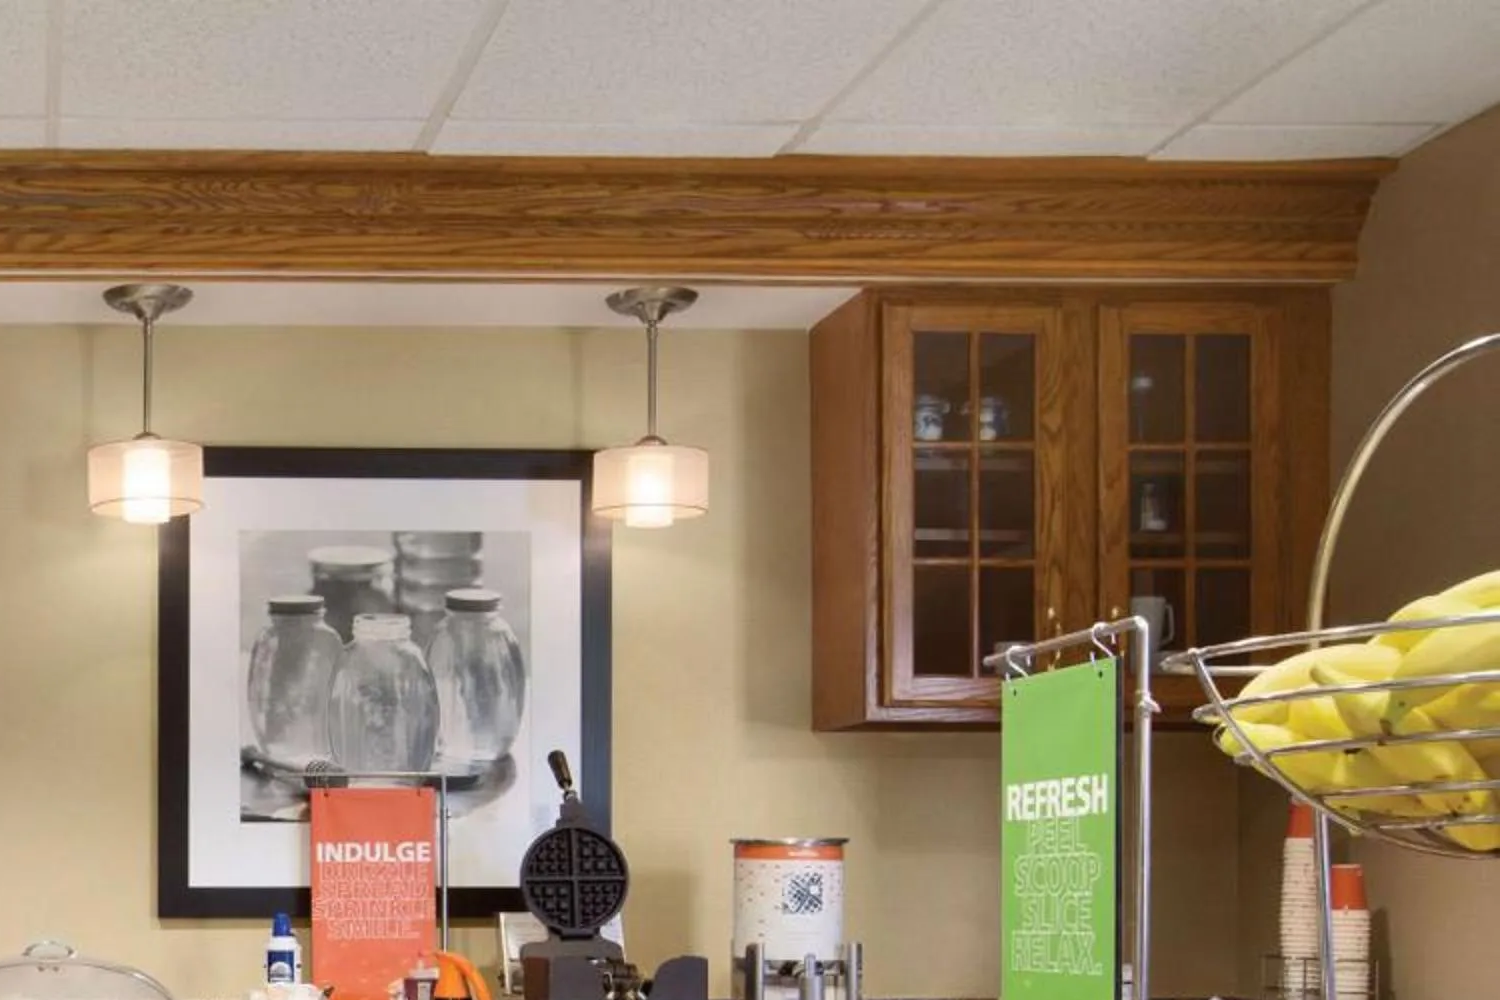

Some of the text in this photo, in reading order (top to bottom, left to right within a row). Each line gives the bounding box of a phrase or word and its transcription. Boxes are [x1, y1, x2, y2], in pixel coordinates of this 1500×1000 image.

[1007, 774, 1108, 820] REFRESH
[316, 841, 432, 863] INDULGE
[1014, 852, 1101, 896] SCOOP
[1021, 892, 1093, 932] SLICE
[1011, 930, 1103, 976] RELAX.
